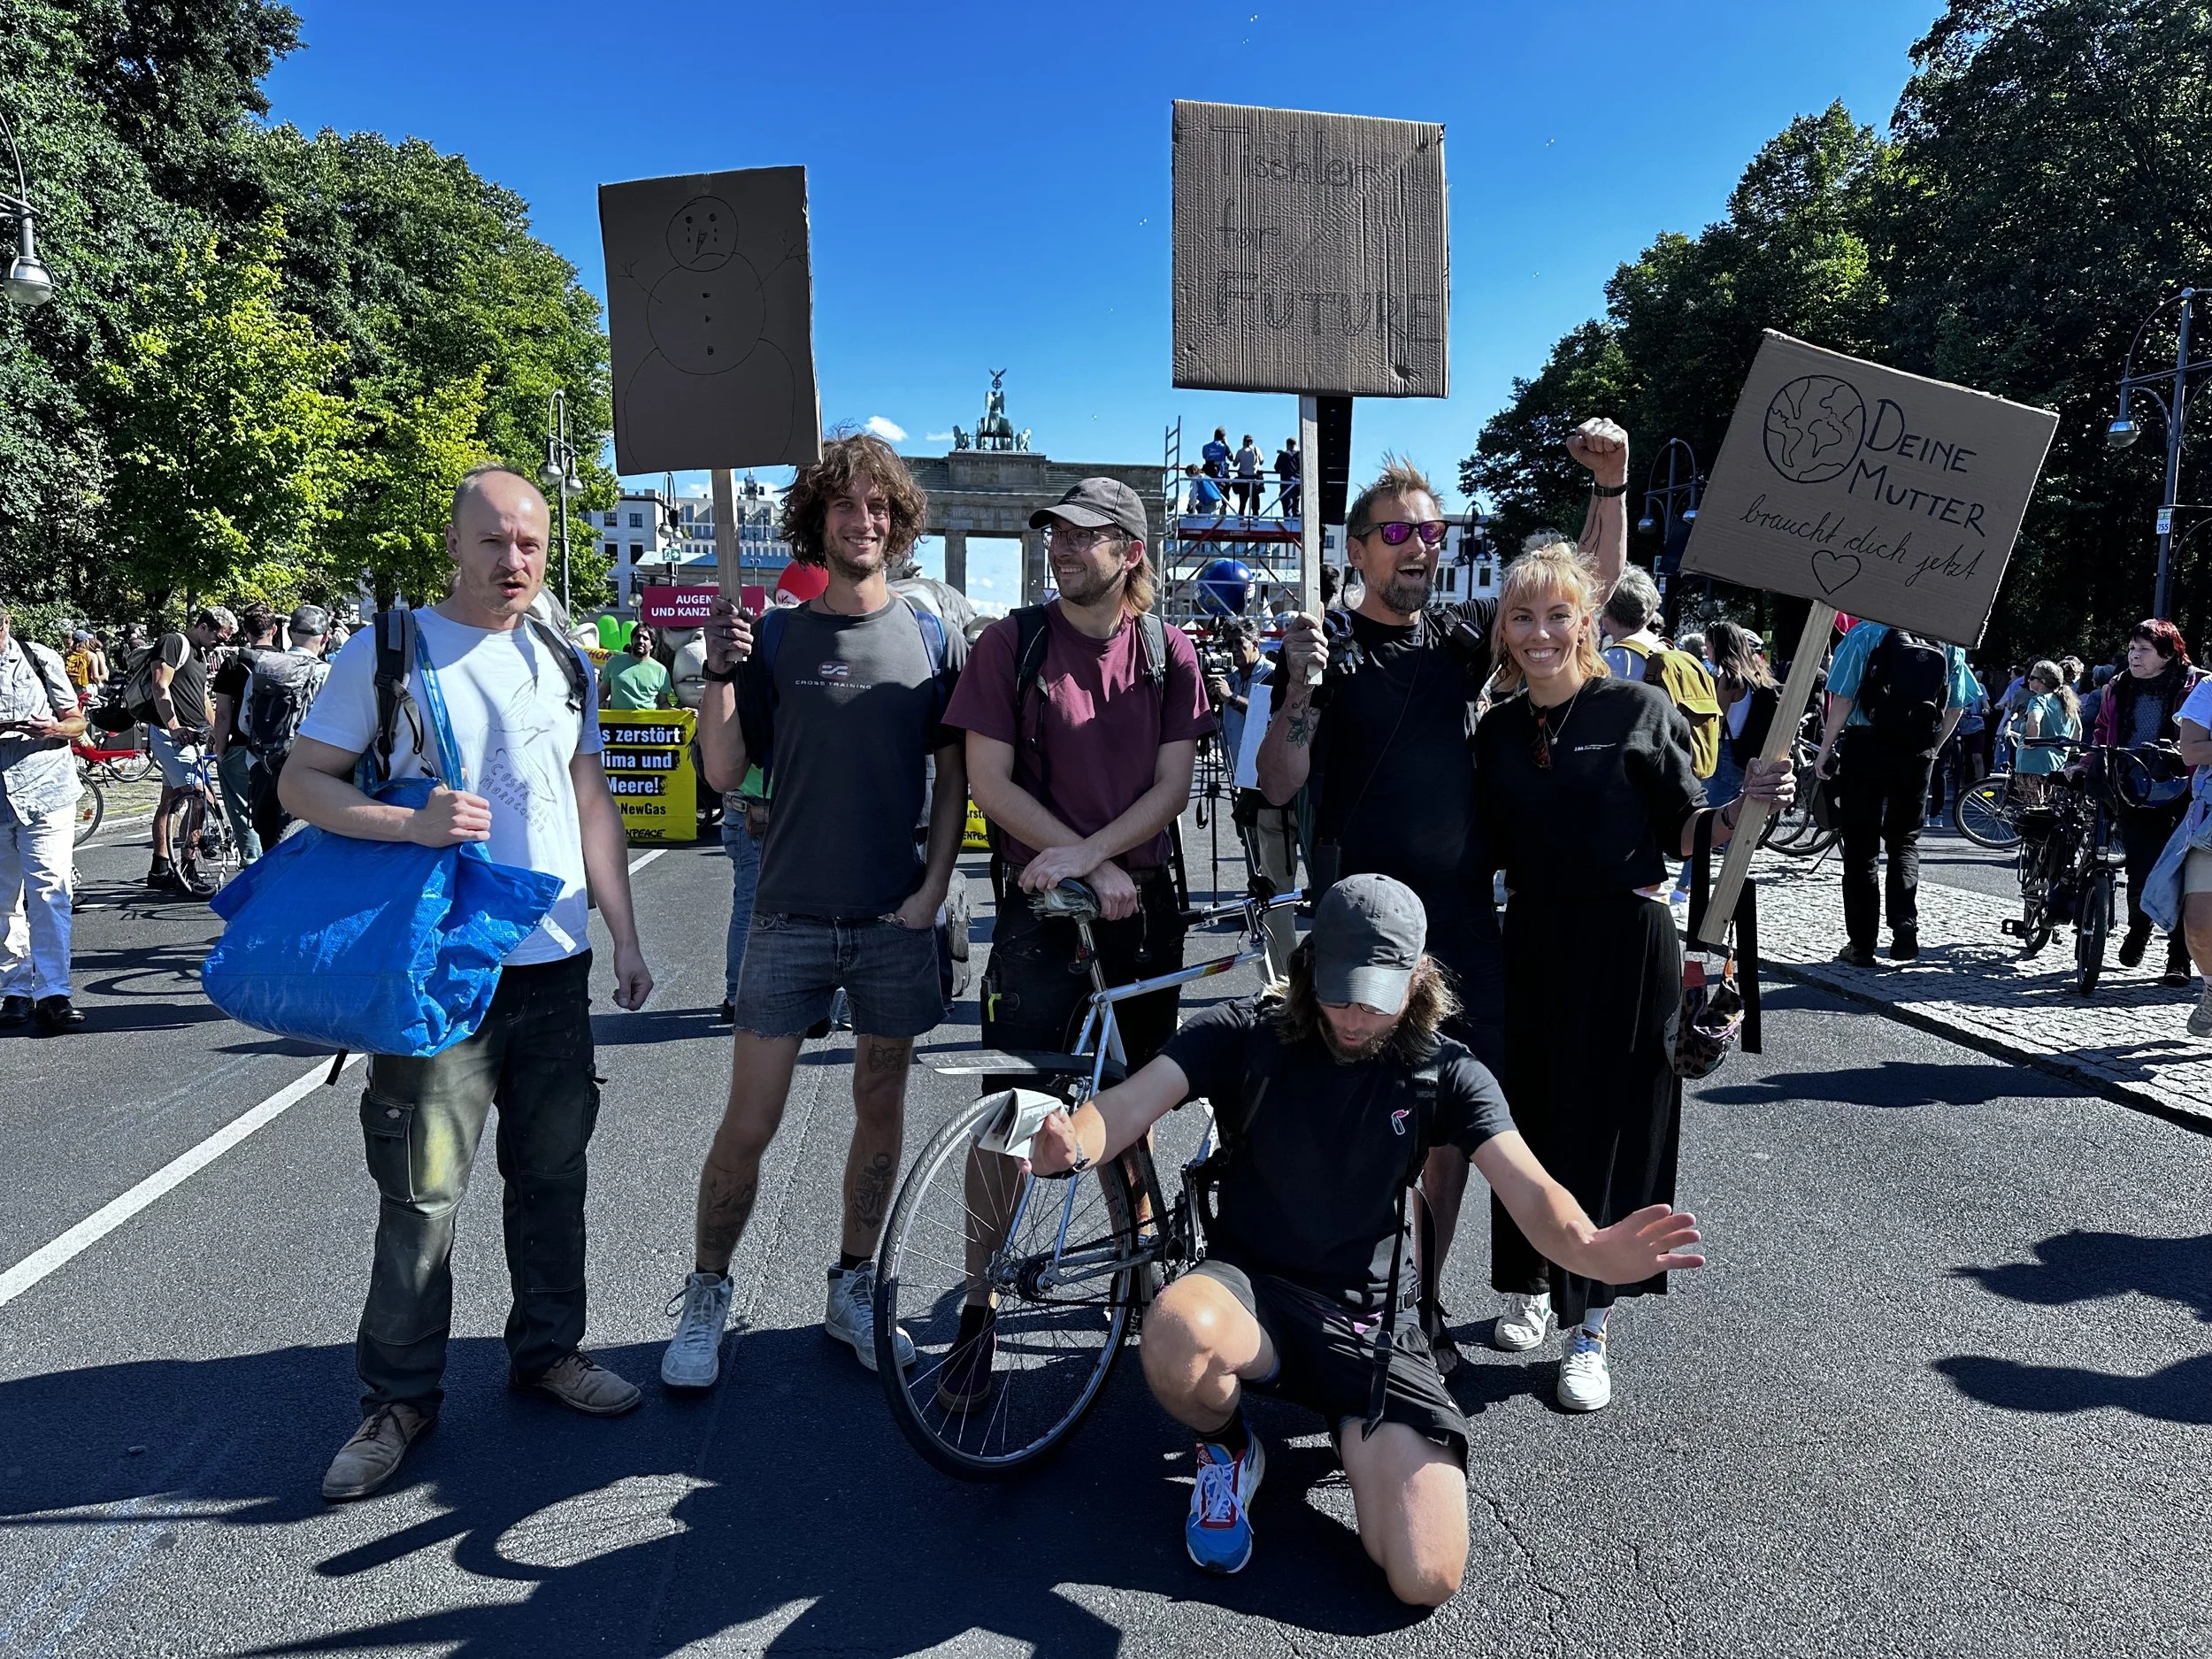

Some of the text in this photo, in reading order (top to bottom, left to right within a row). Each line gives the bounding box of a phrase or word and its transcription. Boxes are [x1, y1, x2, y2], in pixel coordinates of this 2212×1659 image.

[1211, 126, 1376, 187] Tischler
[1216, 198, 1281, 250] for
[1217, 271, 1442, 343] FUTURE
[1740, 494, 1985, 588] braucht dich jetzt
[675, 595, 714, 604] AUGEN
[650, 607, 711, 617] UND KANZL
[615, 727, 680, 743] zerstört
[601, 750, 672, 769] lima und
[490, 763, 531, 802] COSTA
[620, 803, 666, 815] NewGas
[626, 828, 666, 838] NPEACE
